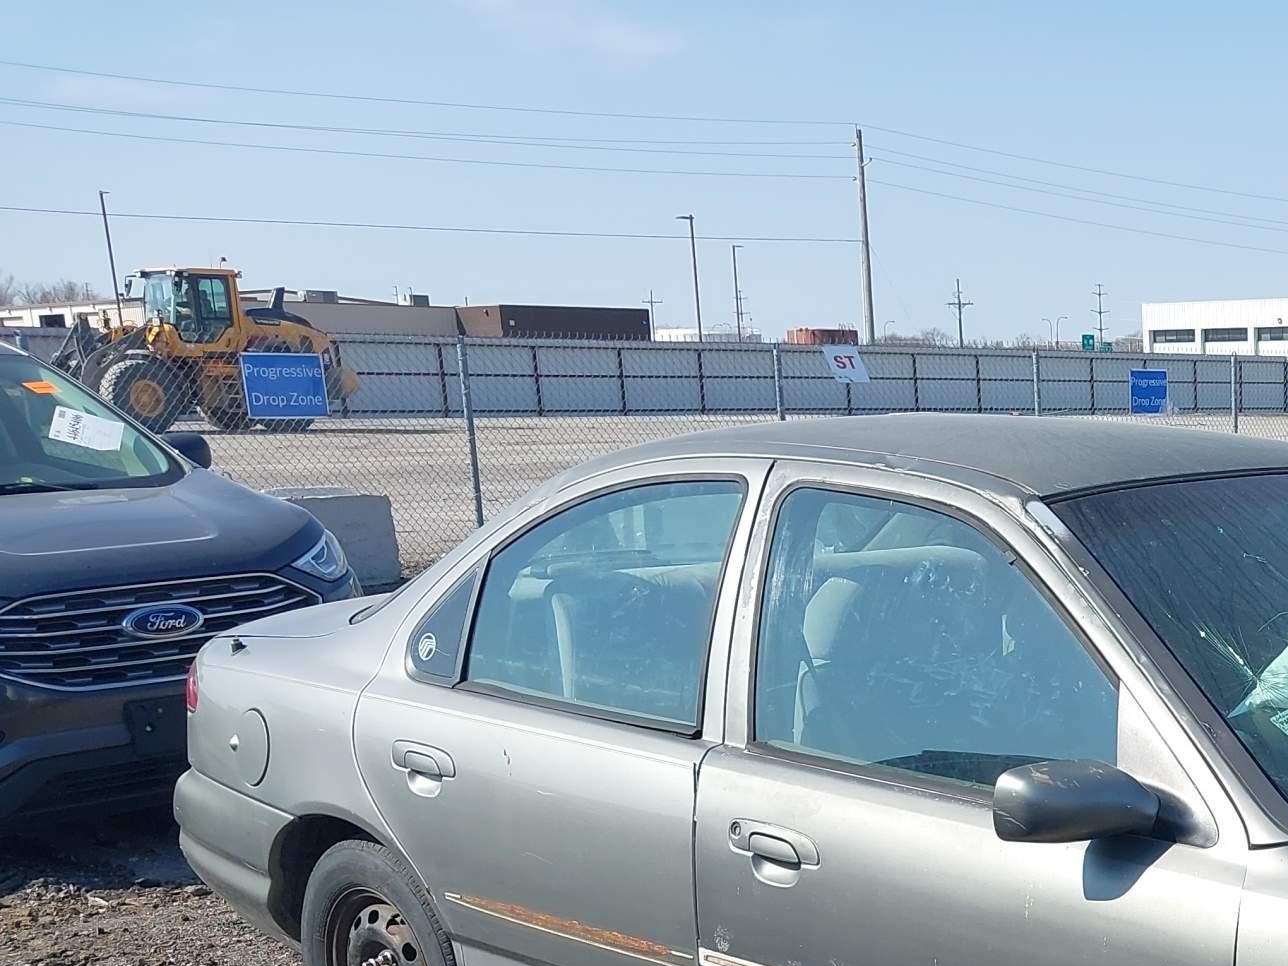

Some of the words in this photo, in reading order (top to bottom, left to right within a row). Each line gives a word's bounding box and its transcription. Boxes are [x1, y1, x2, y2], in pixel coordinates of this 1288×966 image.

[833, 355, 856, 370] ST
[244, 363, 322, 380] Progressive
[251, 392, 287, 407] Drop
[289, 392, 323, 406] Zone
[147, 612, 187, 630] Ford
